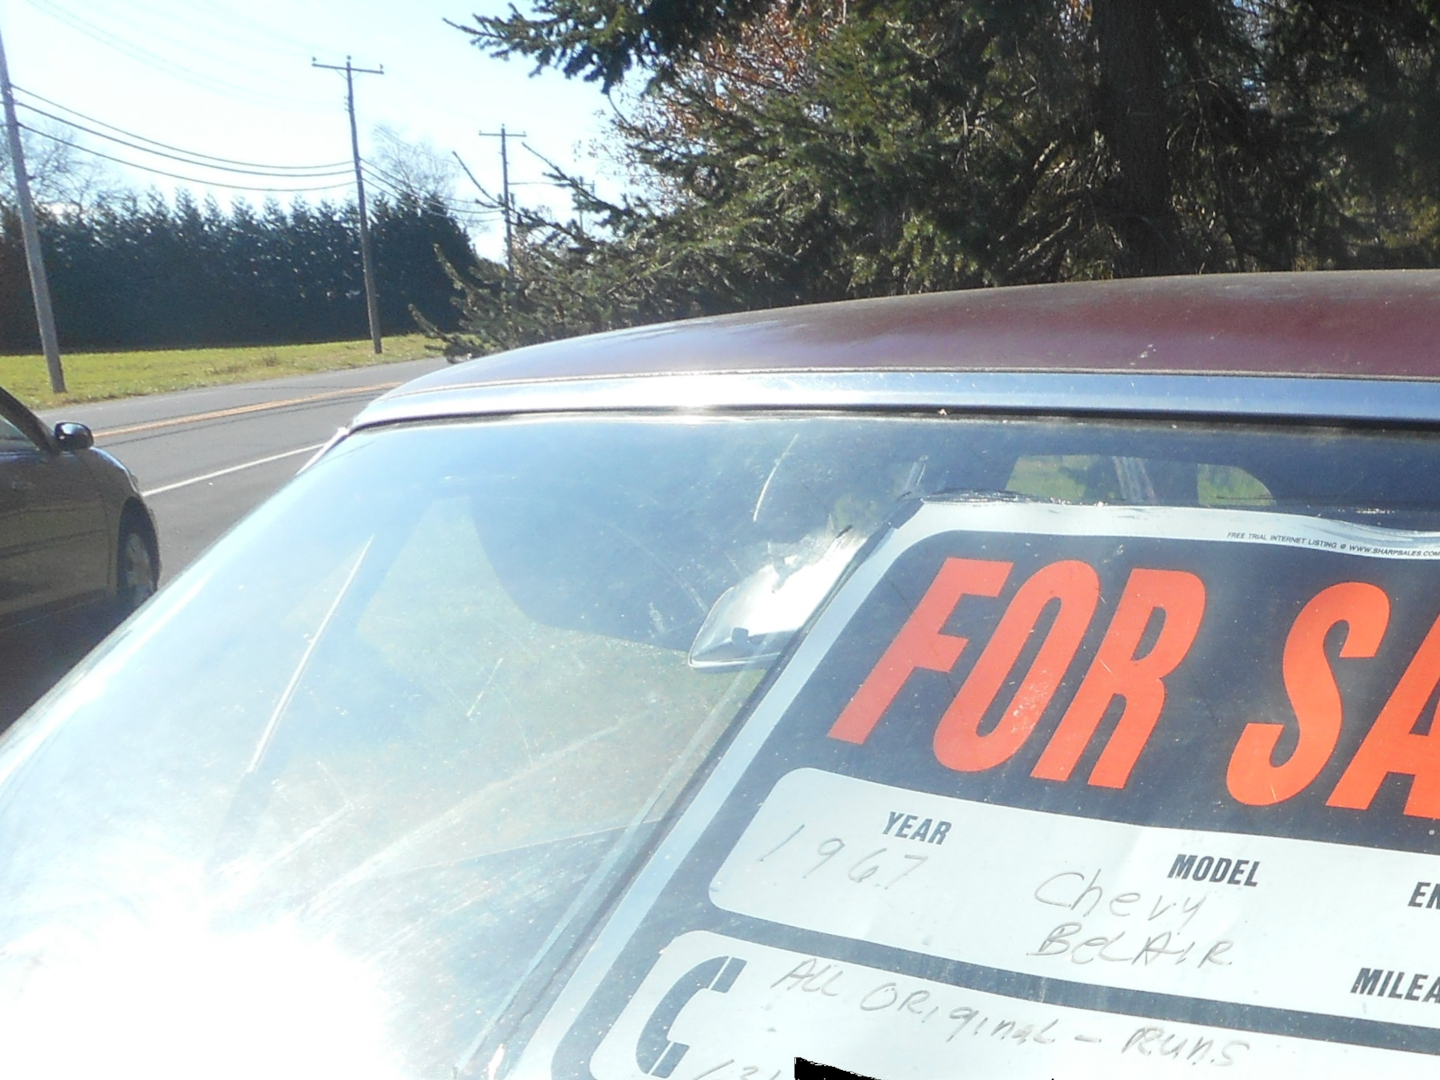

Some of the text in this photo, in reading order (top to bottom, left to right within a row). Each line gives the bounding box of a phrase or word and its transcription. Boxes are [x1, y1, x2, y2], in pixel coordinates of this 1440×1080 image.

[1227, 532, 1246, 540] FREE
[1248, 532, 1267, 541] TRIAL
[1270, 534, 1306, 545] INTERNET
[1308, 539, 1338, 549] LISTING
[1349, 544, 1440, 557] WWW.SHARPSALES.COM
[827, 559, 1205, 788] FOR
[882, 811, 952, 845] YEAR
[758, 824, 929, 891] 1967
[1167, 853, 1261, 887] MODEL
[1034, 869, 1208, 936] Chevy
[769, 958, 840, 998] ALL
